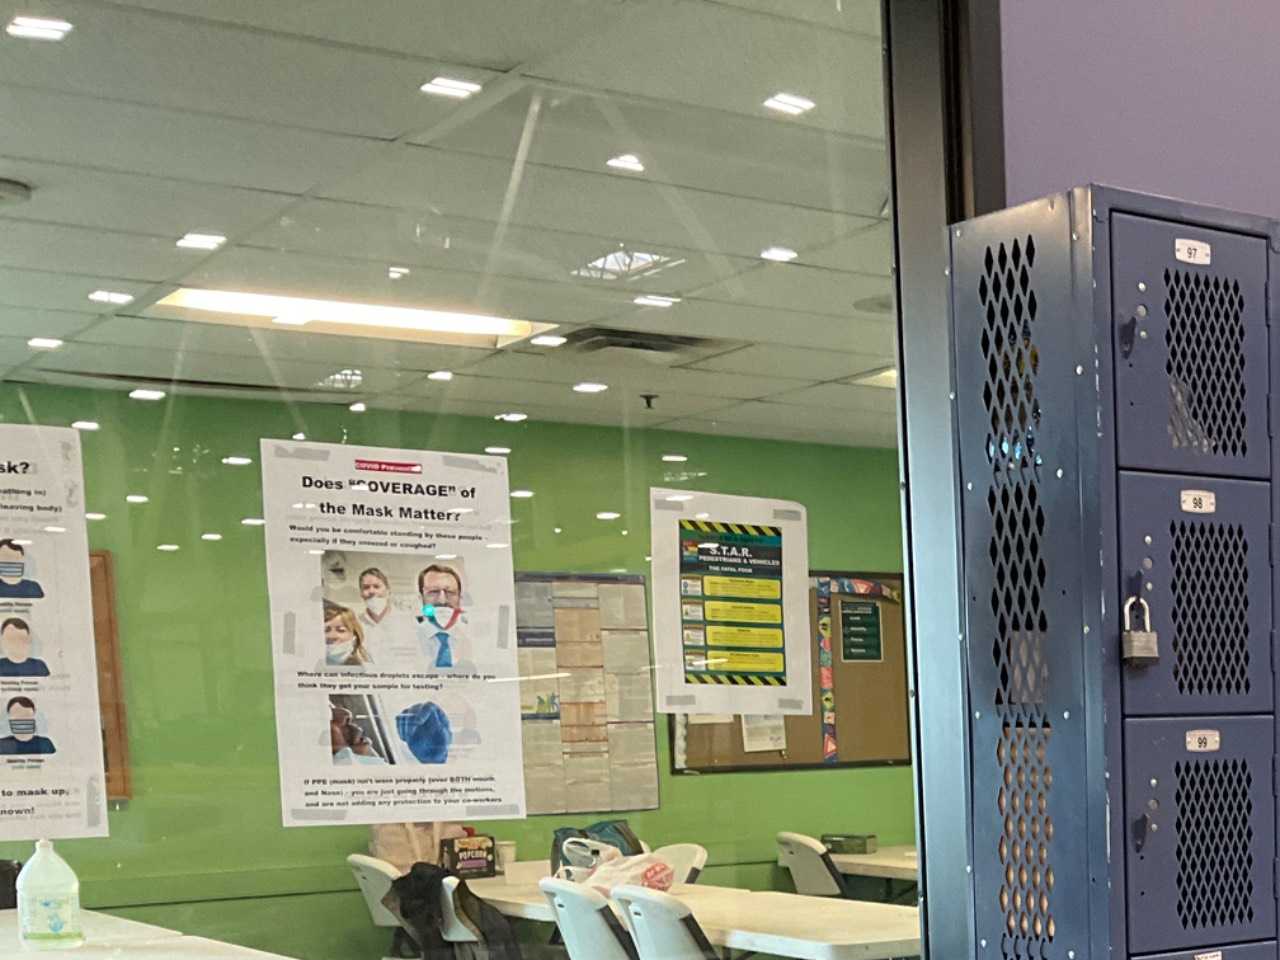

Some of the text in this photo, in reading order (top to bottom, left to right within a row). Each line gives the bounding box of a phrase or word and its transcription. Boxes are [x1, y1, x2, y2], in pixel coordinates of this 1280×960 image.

[1186, 247, 1197, 259] 97
[302, 476, 344, 491] Does
[460, 487, 476, 499] of
[1193, 496, 1203, 509] 98
[320, 502, 461, 522] the Mask Matter?
[709, 546, 753, 558] S.T.A.R.
[1197, 736, 1207, 748] 99
[1, 789, 13, 797] to
[16, 788, 48, 796] mask
